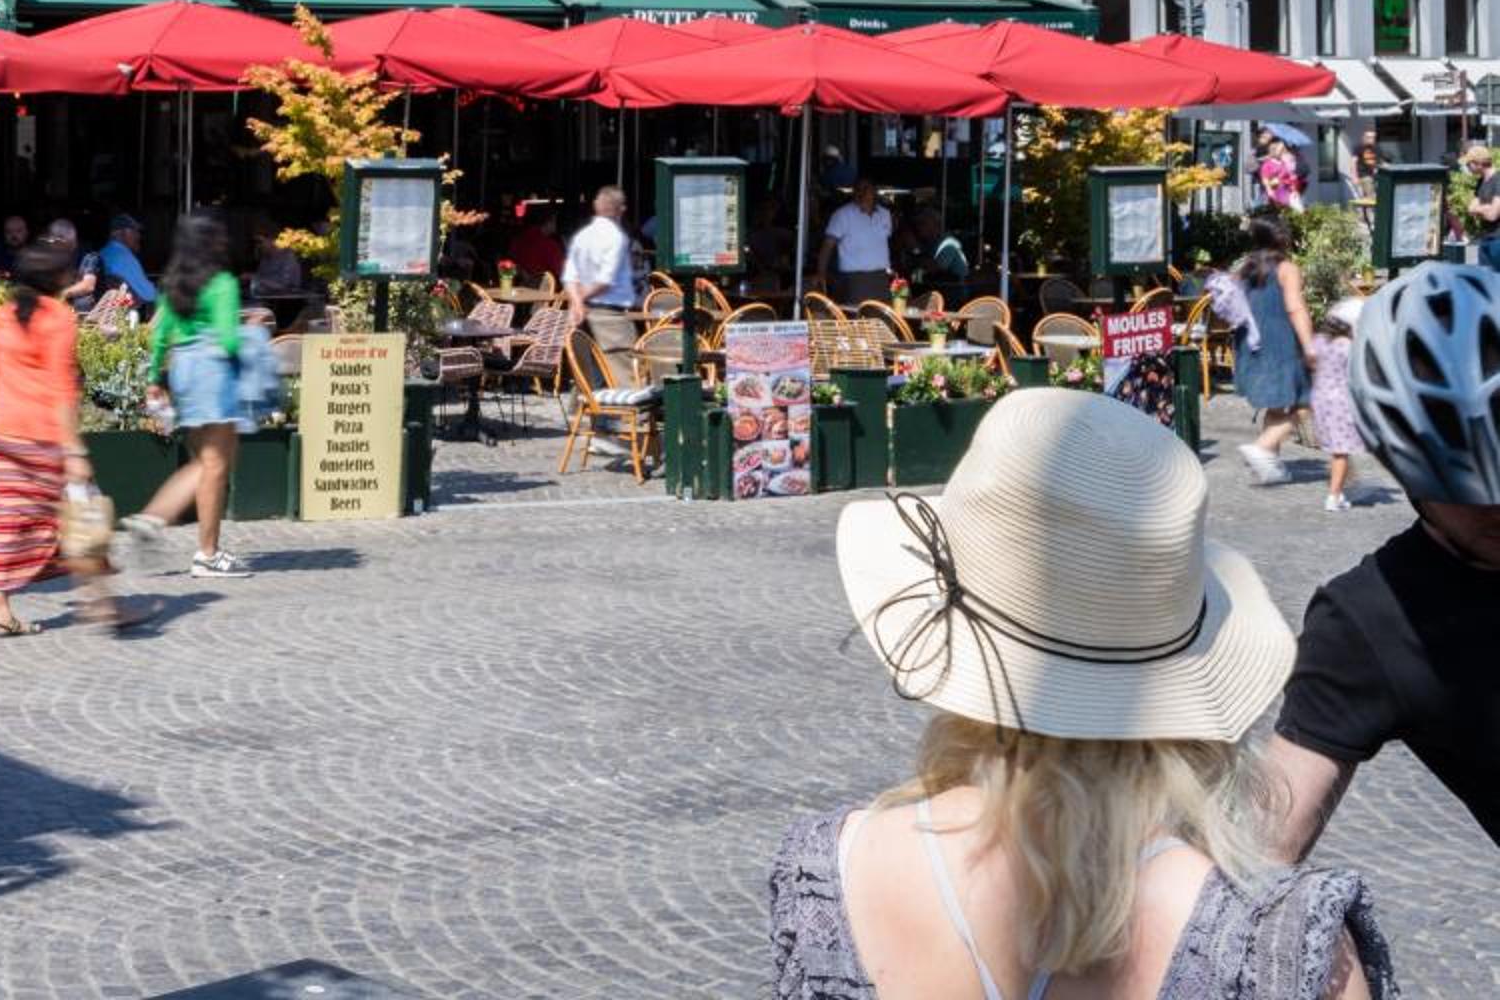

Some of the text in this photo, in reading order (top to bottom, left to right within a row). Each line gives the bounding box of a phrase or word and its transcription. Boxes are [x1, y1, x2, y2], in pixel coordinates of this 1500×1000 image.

[849, 17, 889, 29] Drinks
[1107, 310, 1168, 337] MOULES
[1112, 332, 1164, 356] FRITES
[329, 362, 372, 377] Salades
[330, 381, 370, 396] Pasta's
[327, 401, 372, 416] Burgers
[333, 420, 364, 435] Pizza
[326, 439, 370, 453] Toasties
[319, 458, 375, 473] Omelettes
[313, 478, 379, 491] Sandwiches
[329, 497, 361, 511] Beers
